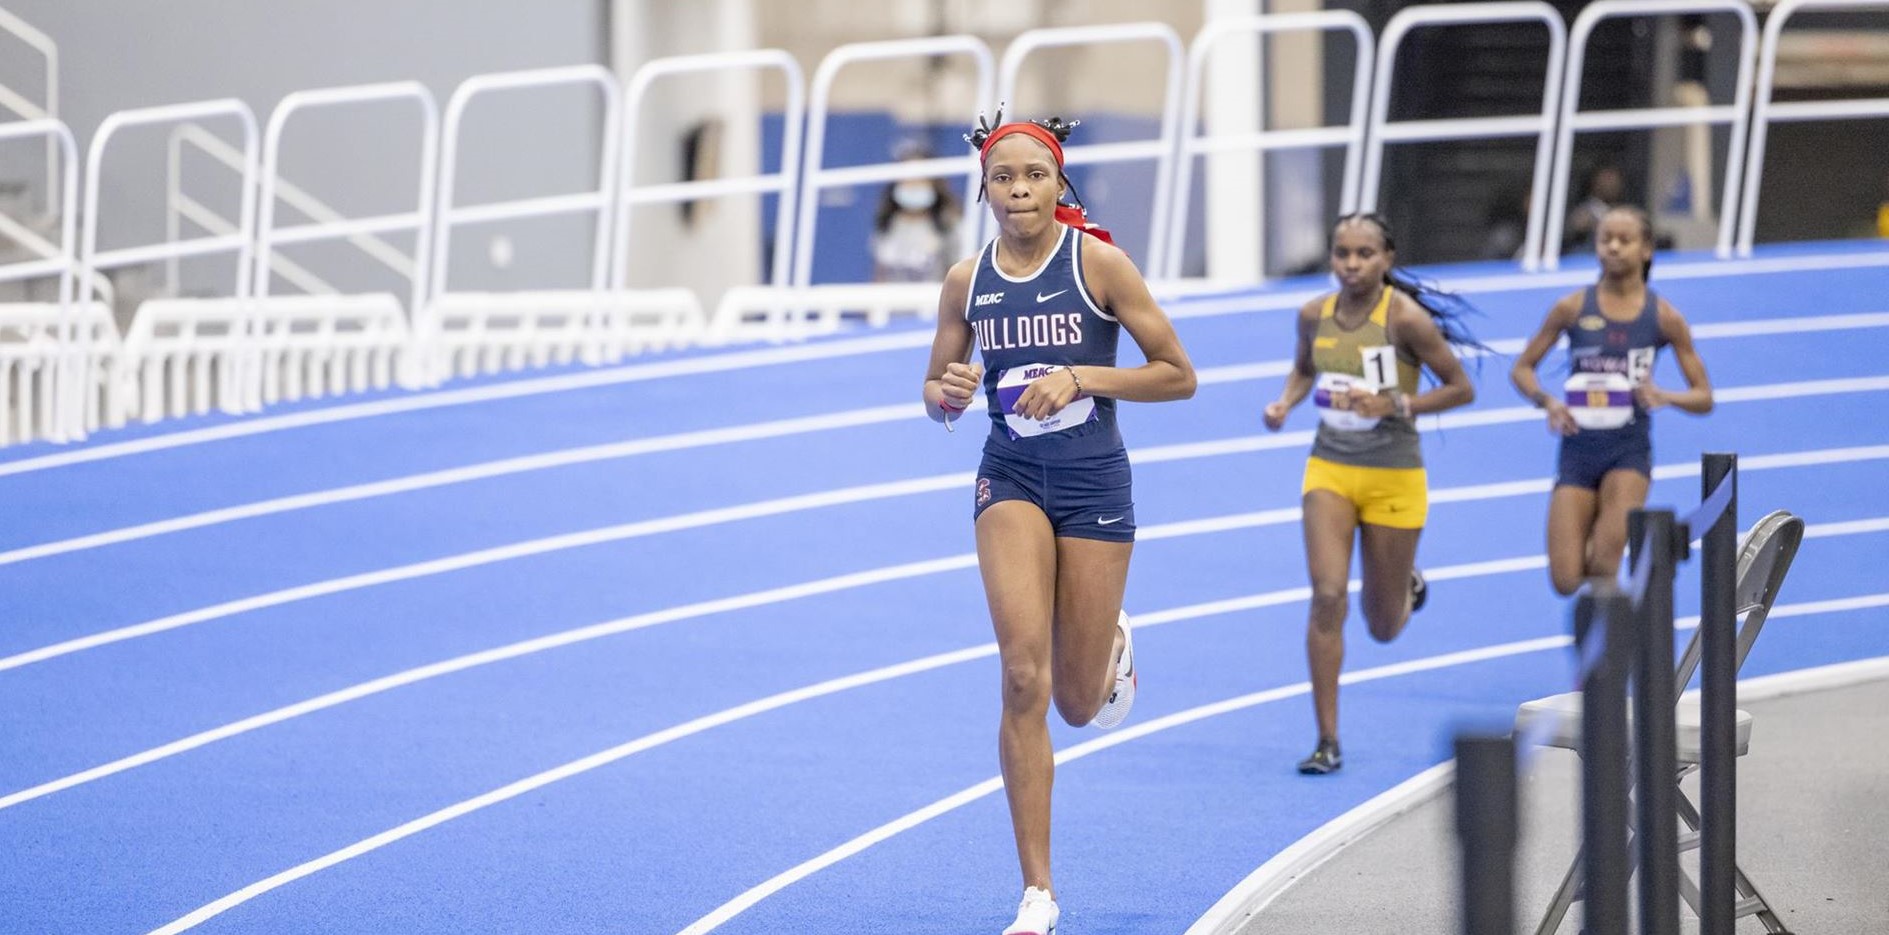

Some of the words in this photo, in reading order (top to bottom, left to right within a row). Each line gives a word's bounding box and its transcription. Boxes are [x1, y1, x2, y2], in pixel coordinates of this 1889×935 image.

[975, 292, 1004, 306] MEAC
[1023, 366, 1054, 380] MEAC
[1369, 353, 1384, 384] 1
